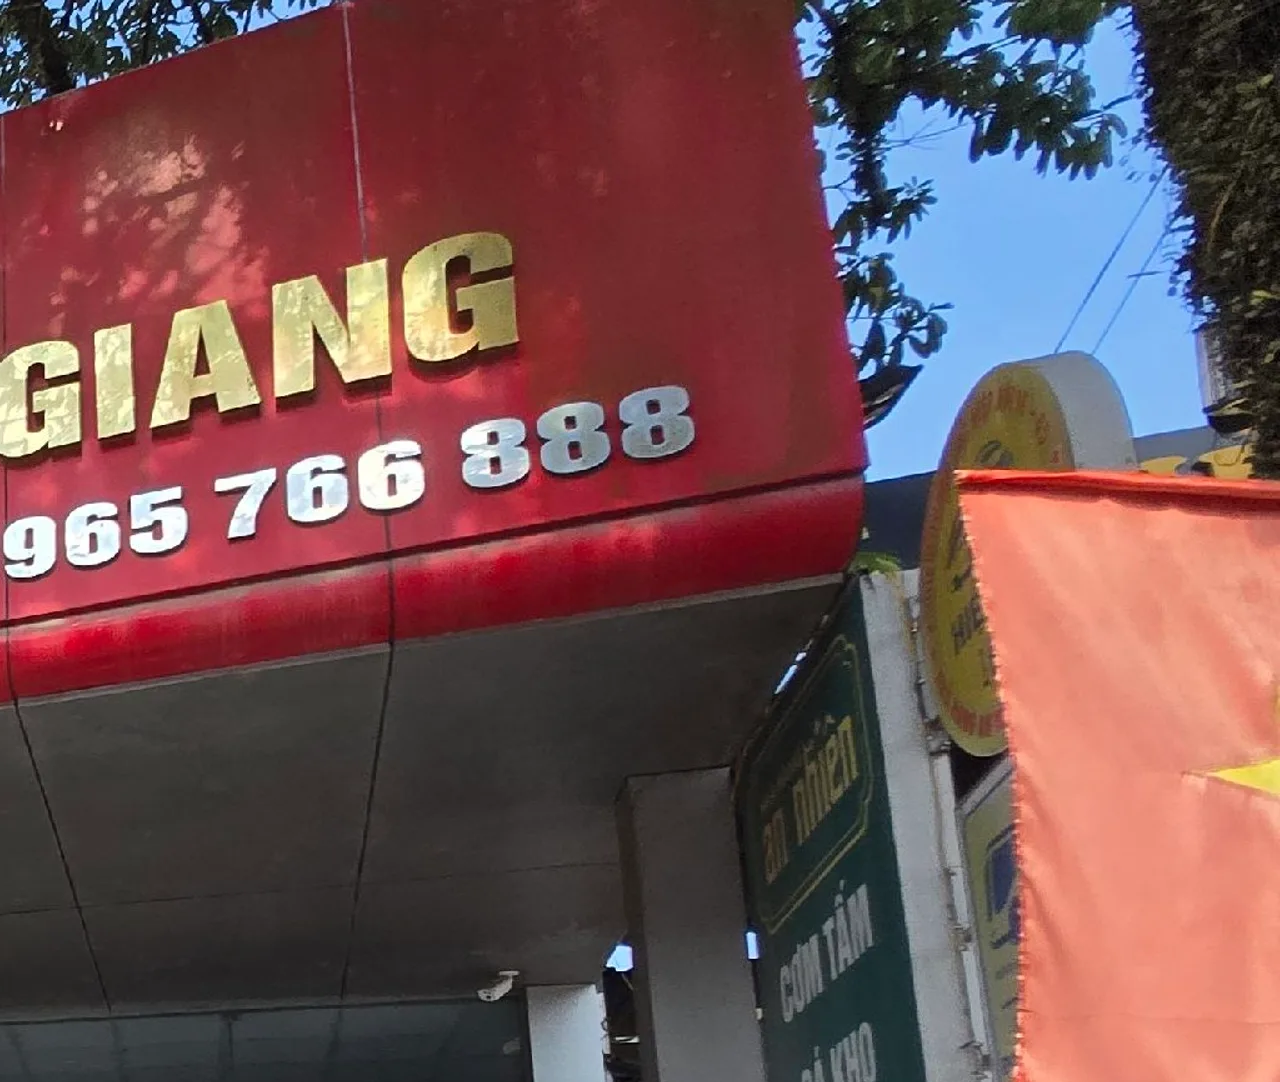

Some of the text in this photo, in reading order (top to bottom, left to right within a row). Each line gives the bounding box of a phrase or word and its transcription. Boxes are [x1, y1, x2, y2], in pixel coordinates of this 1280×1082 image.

[214, 437, 427, 540] 766
[460, 385, 696, 491] 888
[780, 934, 822, 1022] CƠM
